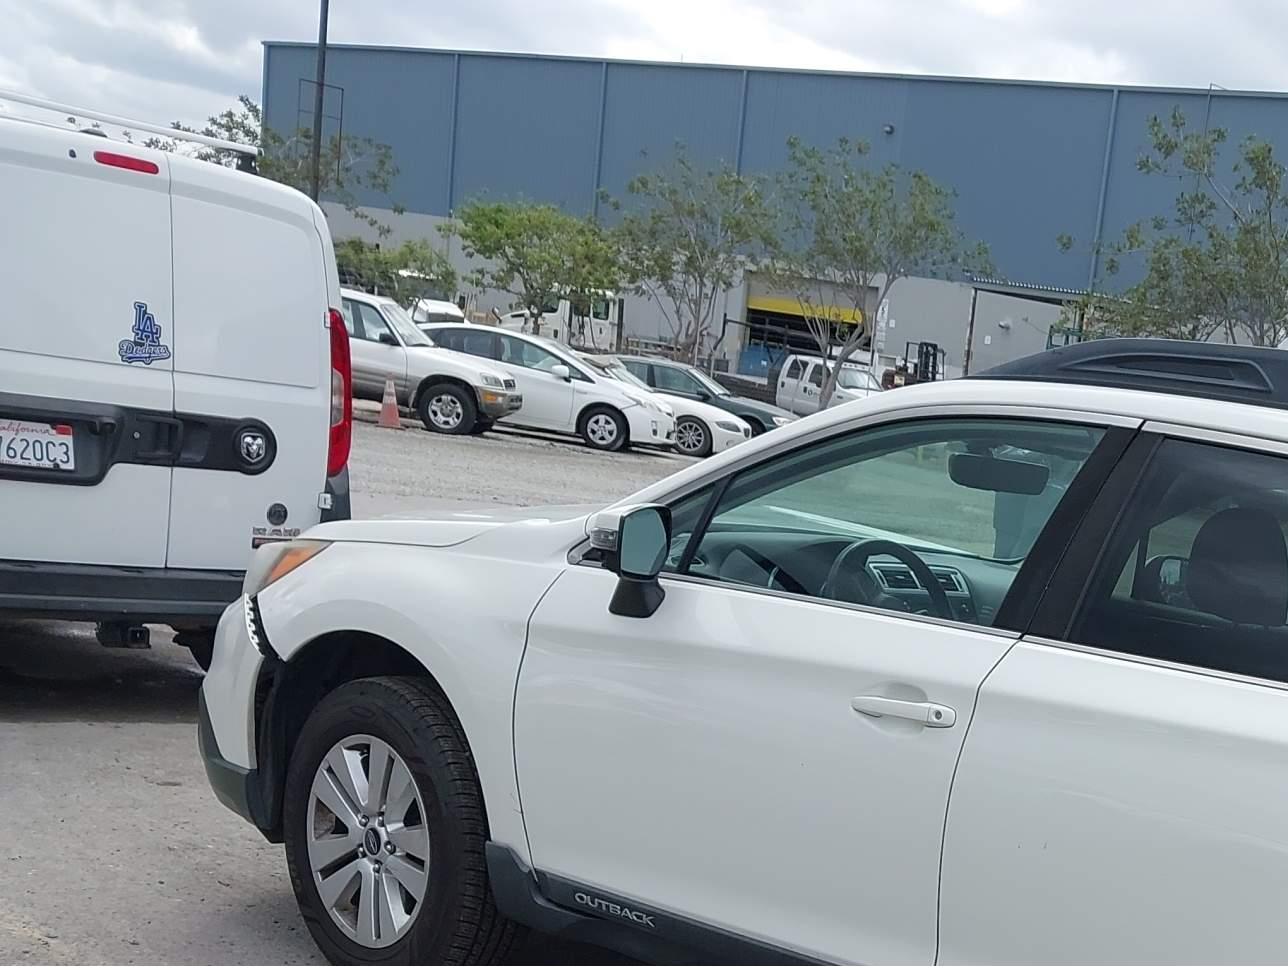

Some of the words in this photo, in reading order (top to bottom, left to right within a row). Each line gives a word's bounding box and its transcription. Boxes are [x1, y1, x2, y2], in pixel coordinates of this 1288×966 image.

[133, 302, 161, 345] LA
[120, 340, 170, 361] Dodgers
[0, 421, 50, 437] alifornia
[574, 892, 656, 928] OUTBACK
